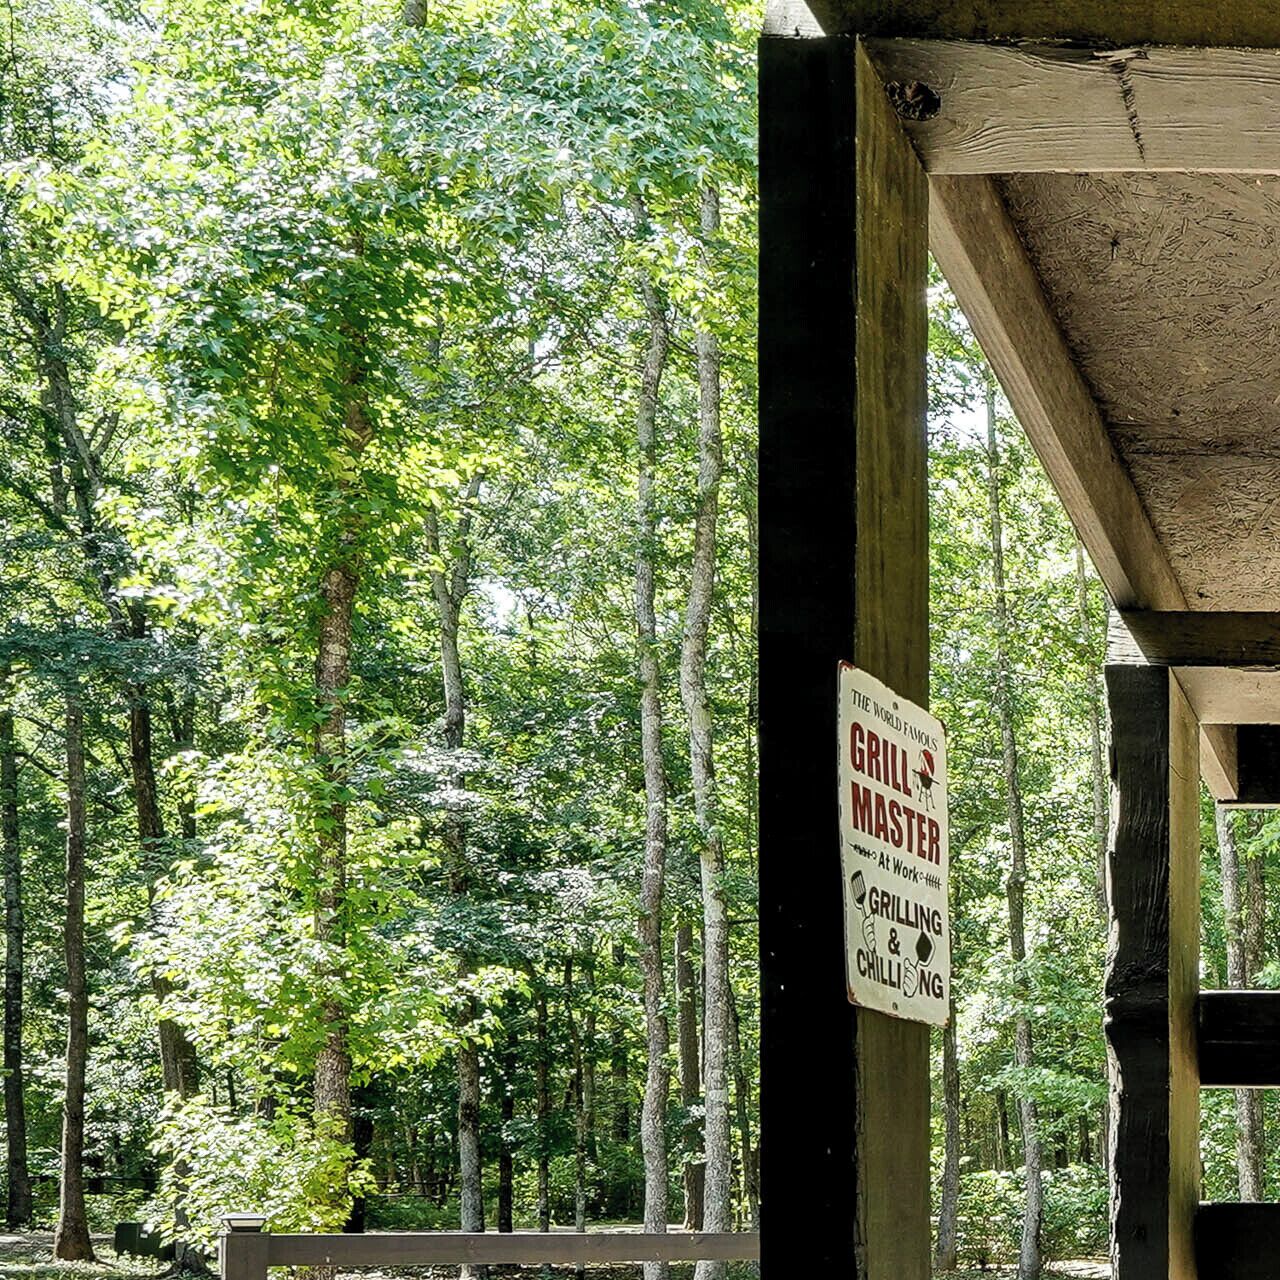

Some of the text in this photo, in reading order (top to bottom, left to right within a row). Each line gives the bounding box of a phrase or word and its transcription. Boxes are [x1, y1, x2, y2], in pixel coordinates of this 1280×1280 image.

[852, 688, 938, 752] THE WORLD FAMOUS
[851, 721, 912, 798] GRILL
[851, 780, 940, 866] MASTER
[878, 851, 919, 884] At Work
[868, 886, 943, 937] GRILLING
[888, 927, 900, 957] &
